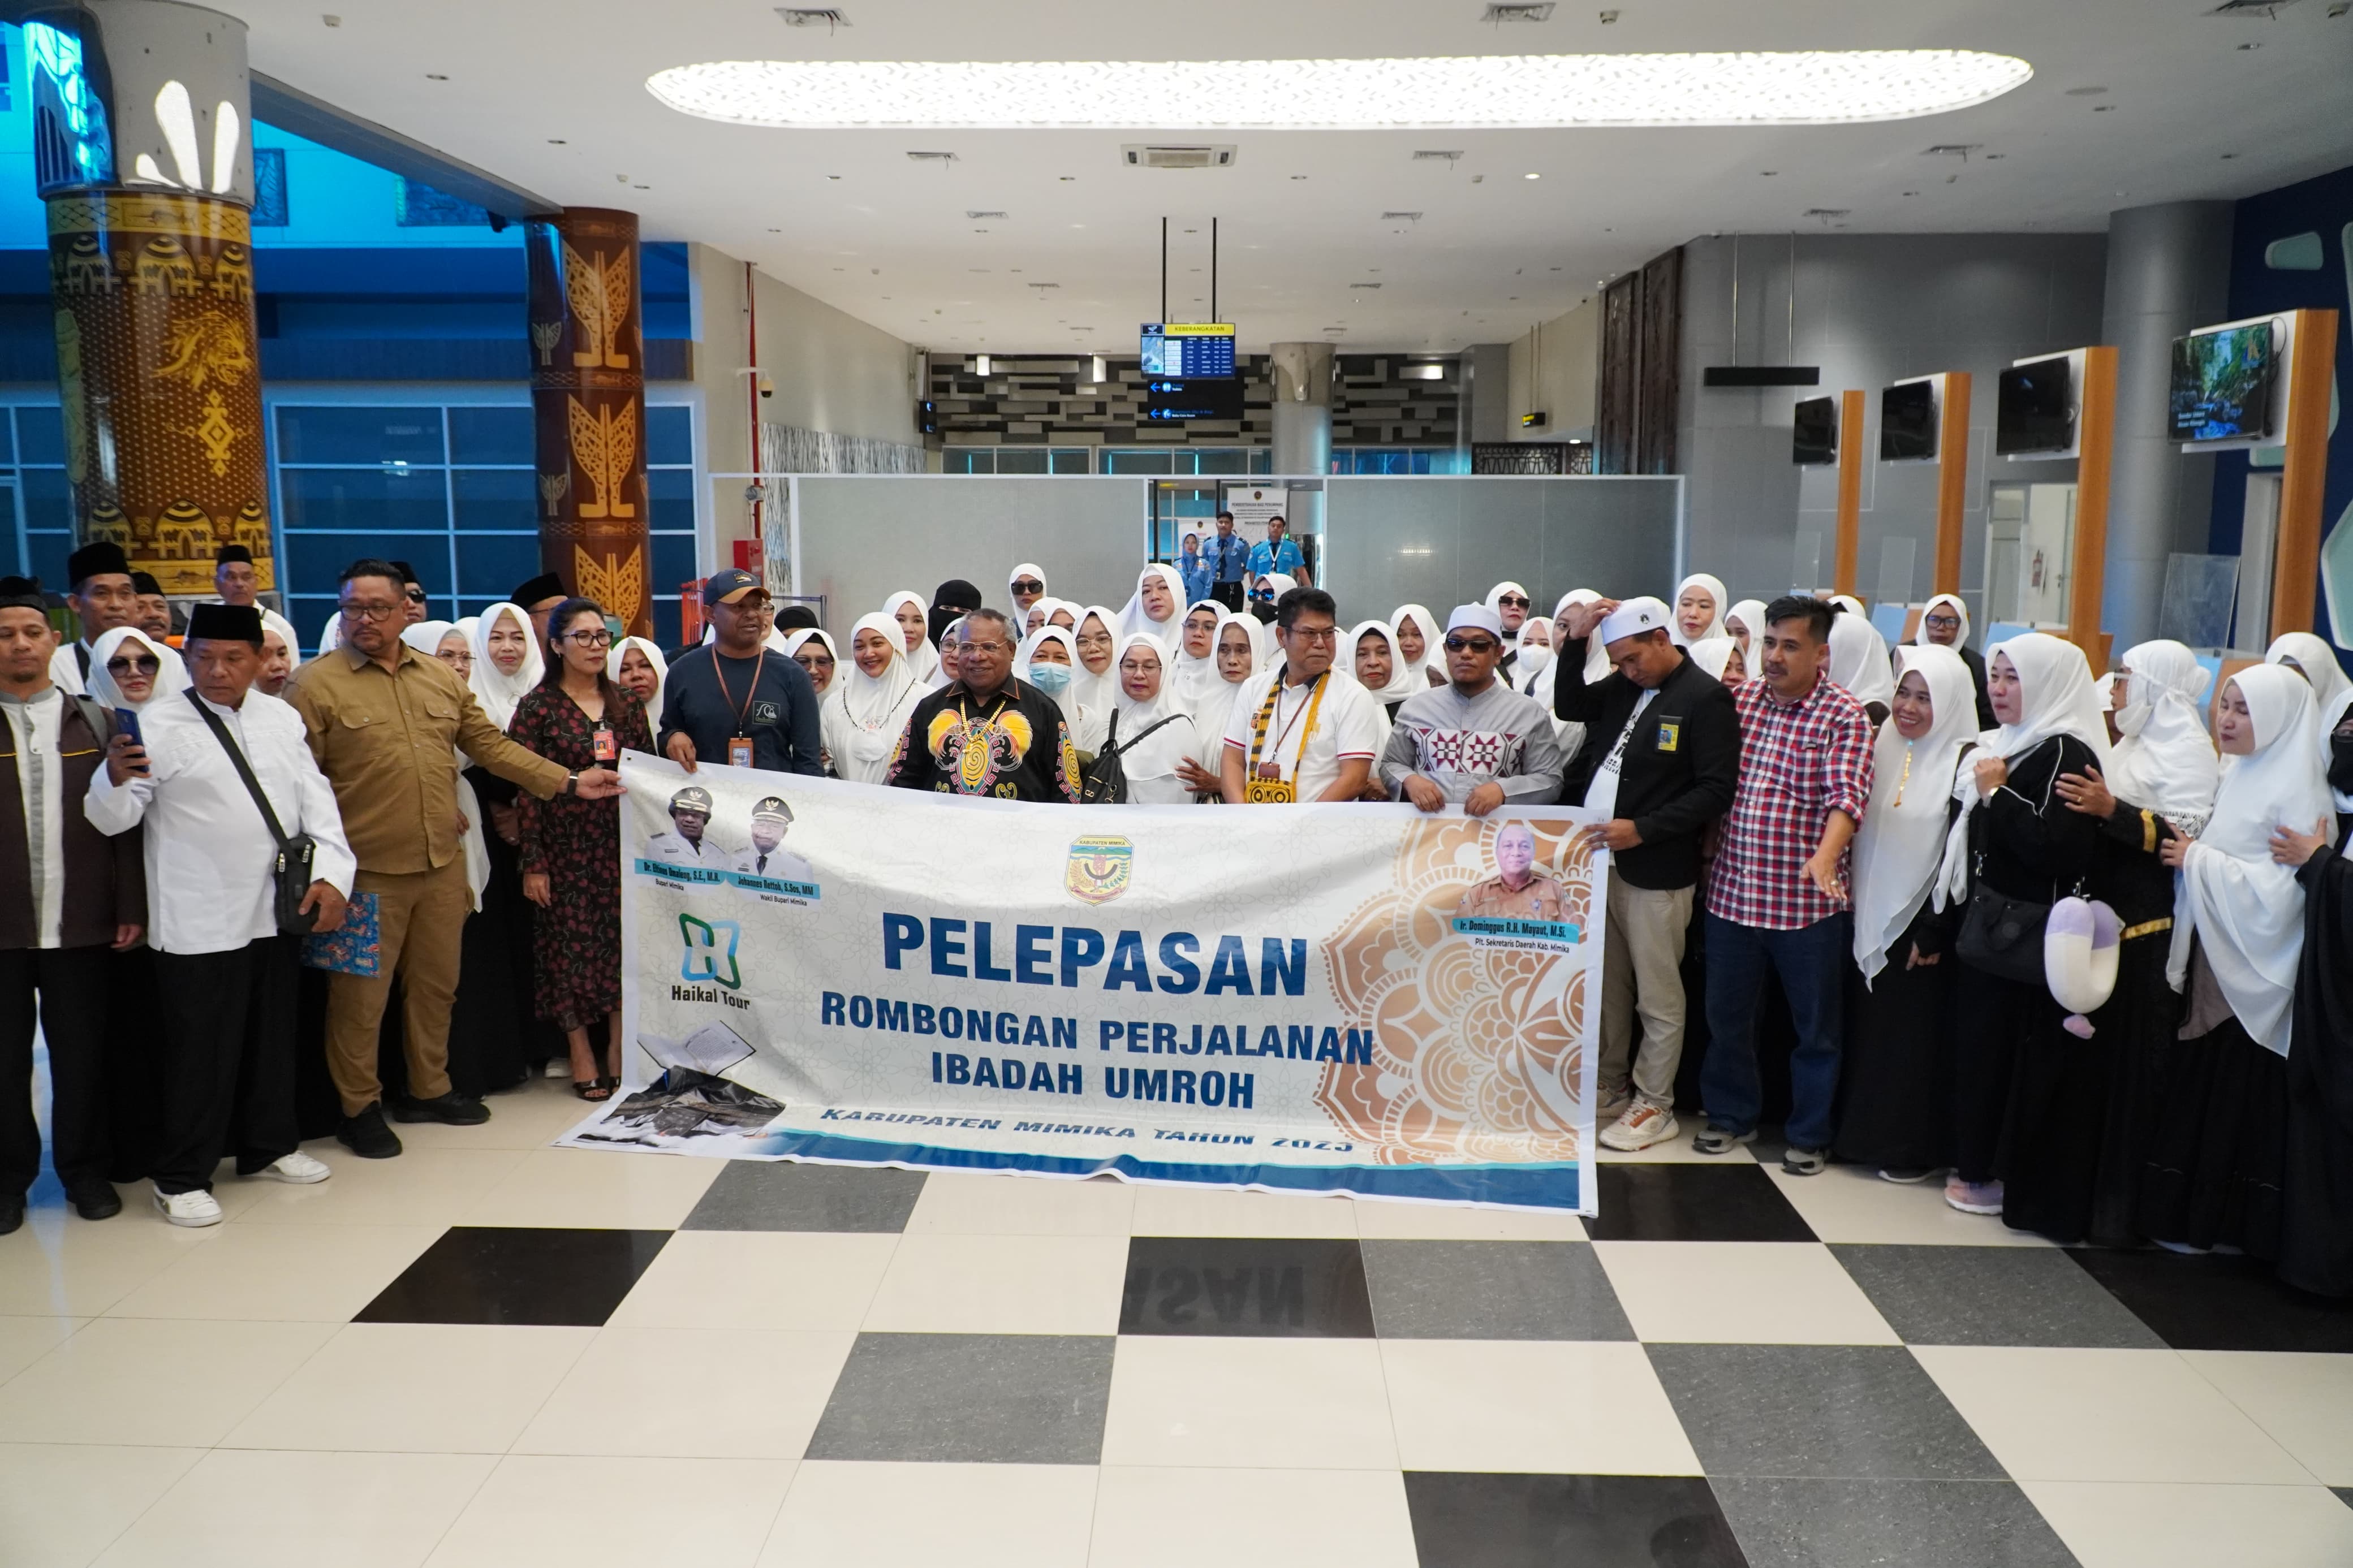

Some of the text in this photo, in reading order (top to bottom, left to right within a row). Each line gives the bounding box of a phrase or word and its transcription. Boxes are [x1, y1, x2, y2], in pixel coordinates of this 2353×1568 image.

[738, 876, 762, 888] Johannes
[785, 883, 801, 895] S.Sos,
[802, 885, 813, 896] MM
[1469, 921, 1505, 933] Dominggus
[1506, 922, 1519, 933] R.H.
[1522, 923, 1549, 938] Mayaut,
[1550, 926, 1566, 938] M.Si.
[1475, 938, 1570, 953] Plt. Sekretaris Daerah Kab. Mimika
[882, 912, 1307, 997] PELEPASAN
[671, 985, 750, 1010] Haikal Tour
[821, 991, 1373, 1066] ROMBONGAN PERJALANAN
[932, 1051, 1255, 1109] IBADAH UMROH
[820, 1109, 1353, 1152] KABUPATEN MIMIKA TAHUN 2023
